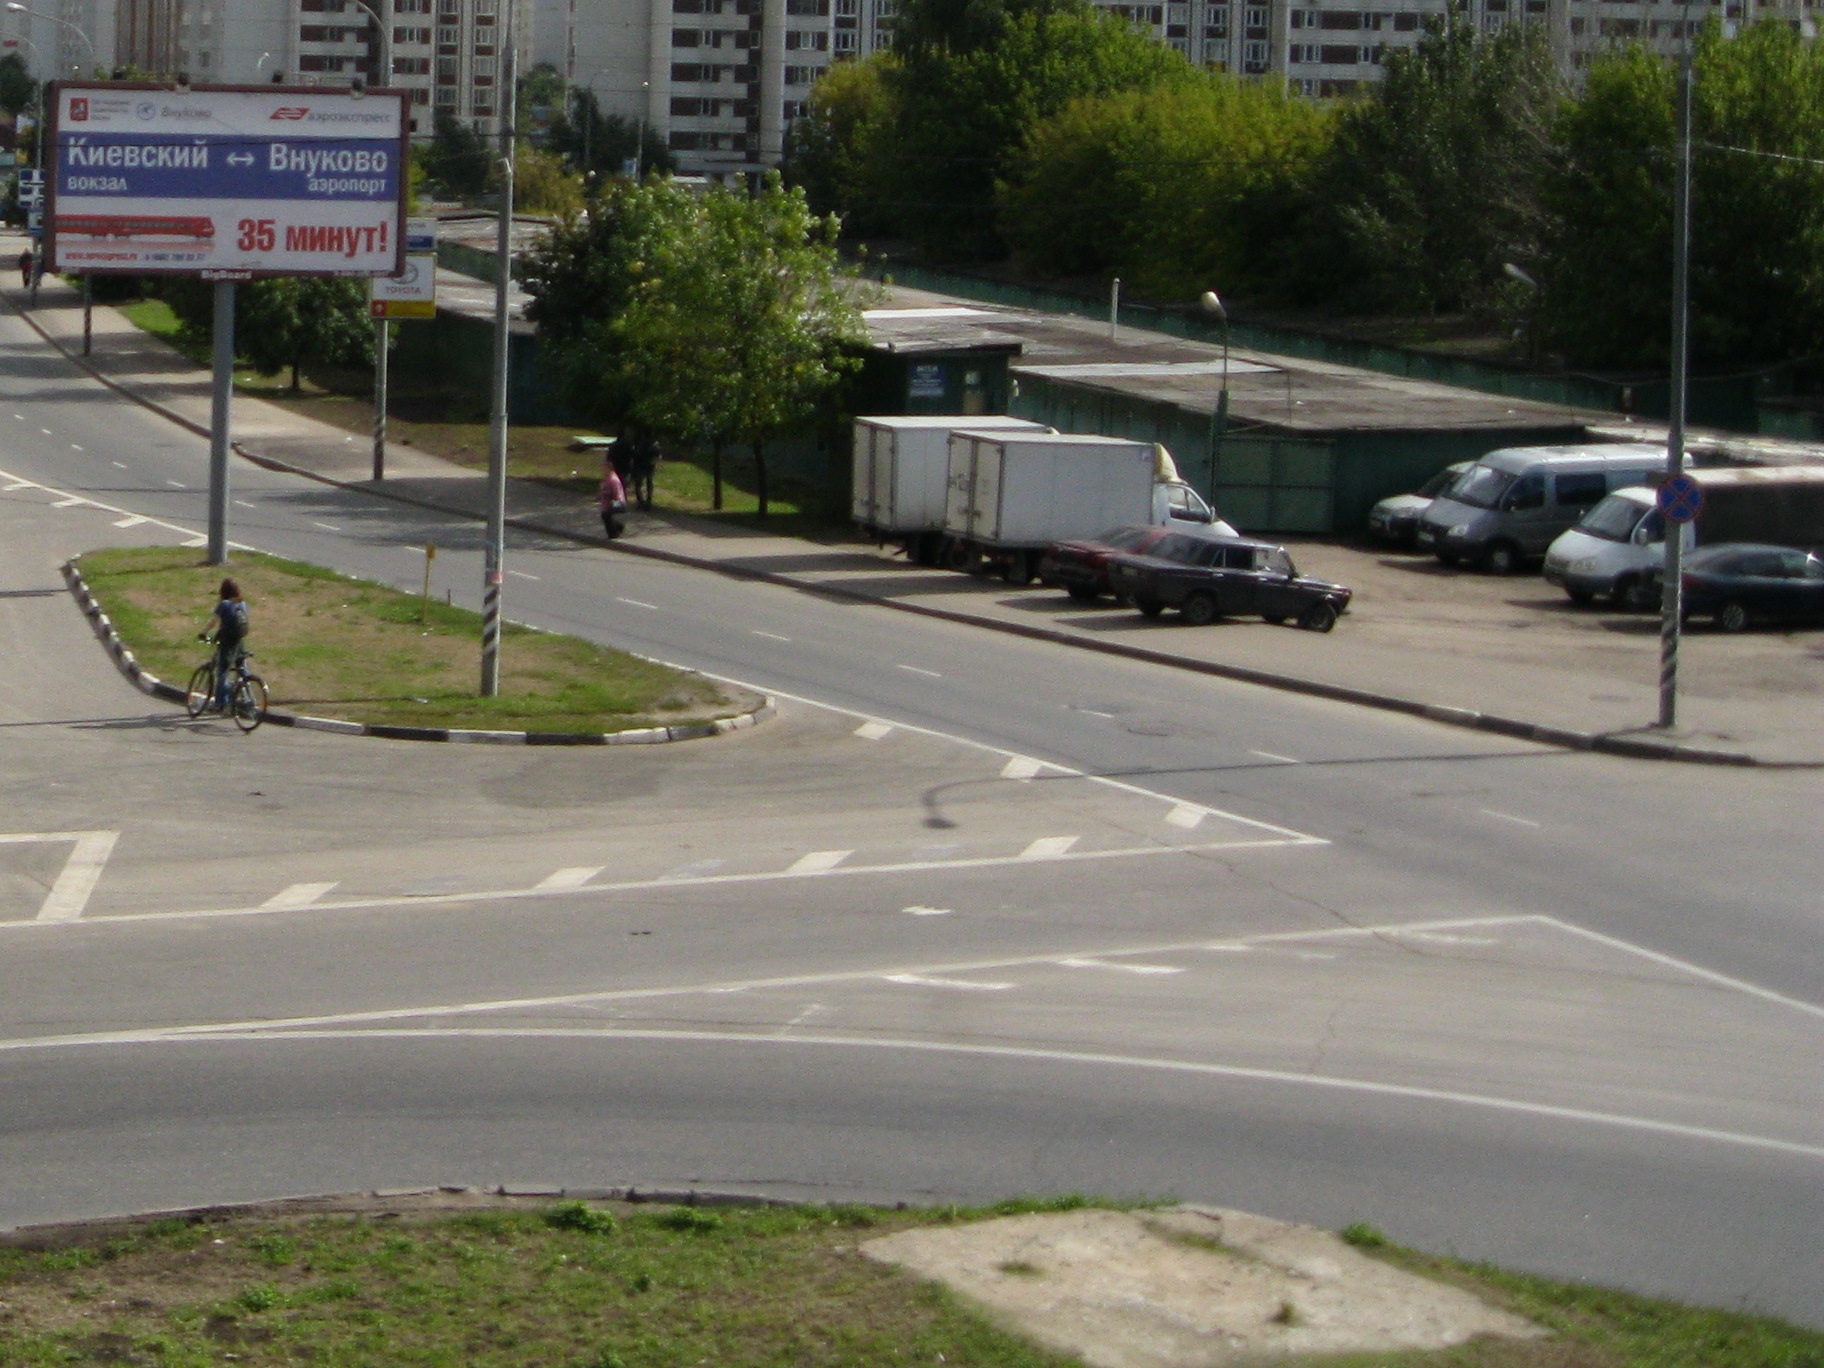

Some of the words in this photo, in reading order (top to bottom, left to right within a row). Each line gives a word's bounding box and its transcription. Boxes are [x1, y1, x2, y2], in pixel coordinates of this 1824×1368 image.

[67, 136, 209, 168] Киевский
[268, 142, 389, 178] Внуково
[67, 174, 128, 192] вокзал
[307, 178, 387, 195] аэропорт
[237, 218, 277, 252] 35
[285, 220, 389, 259] минут!
[384, 285, 422, 295] TOYOTA
